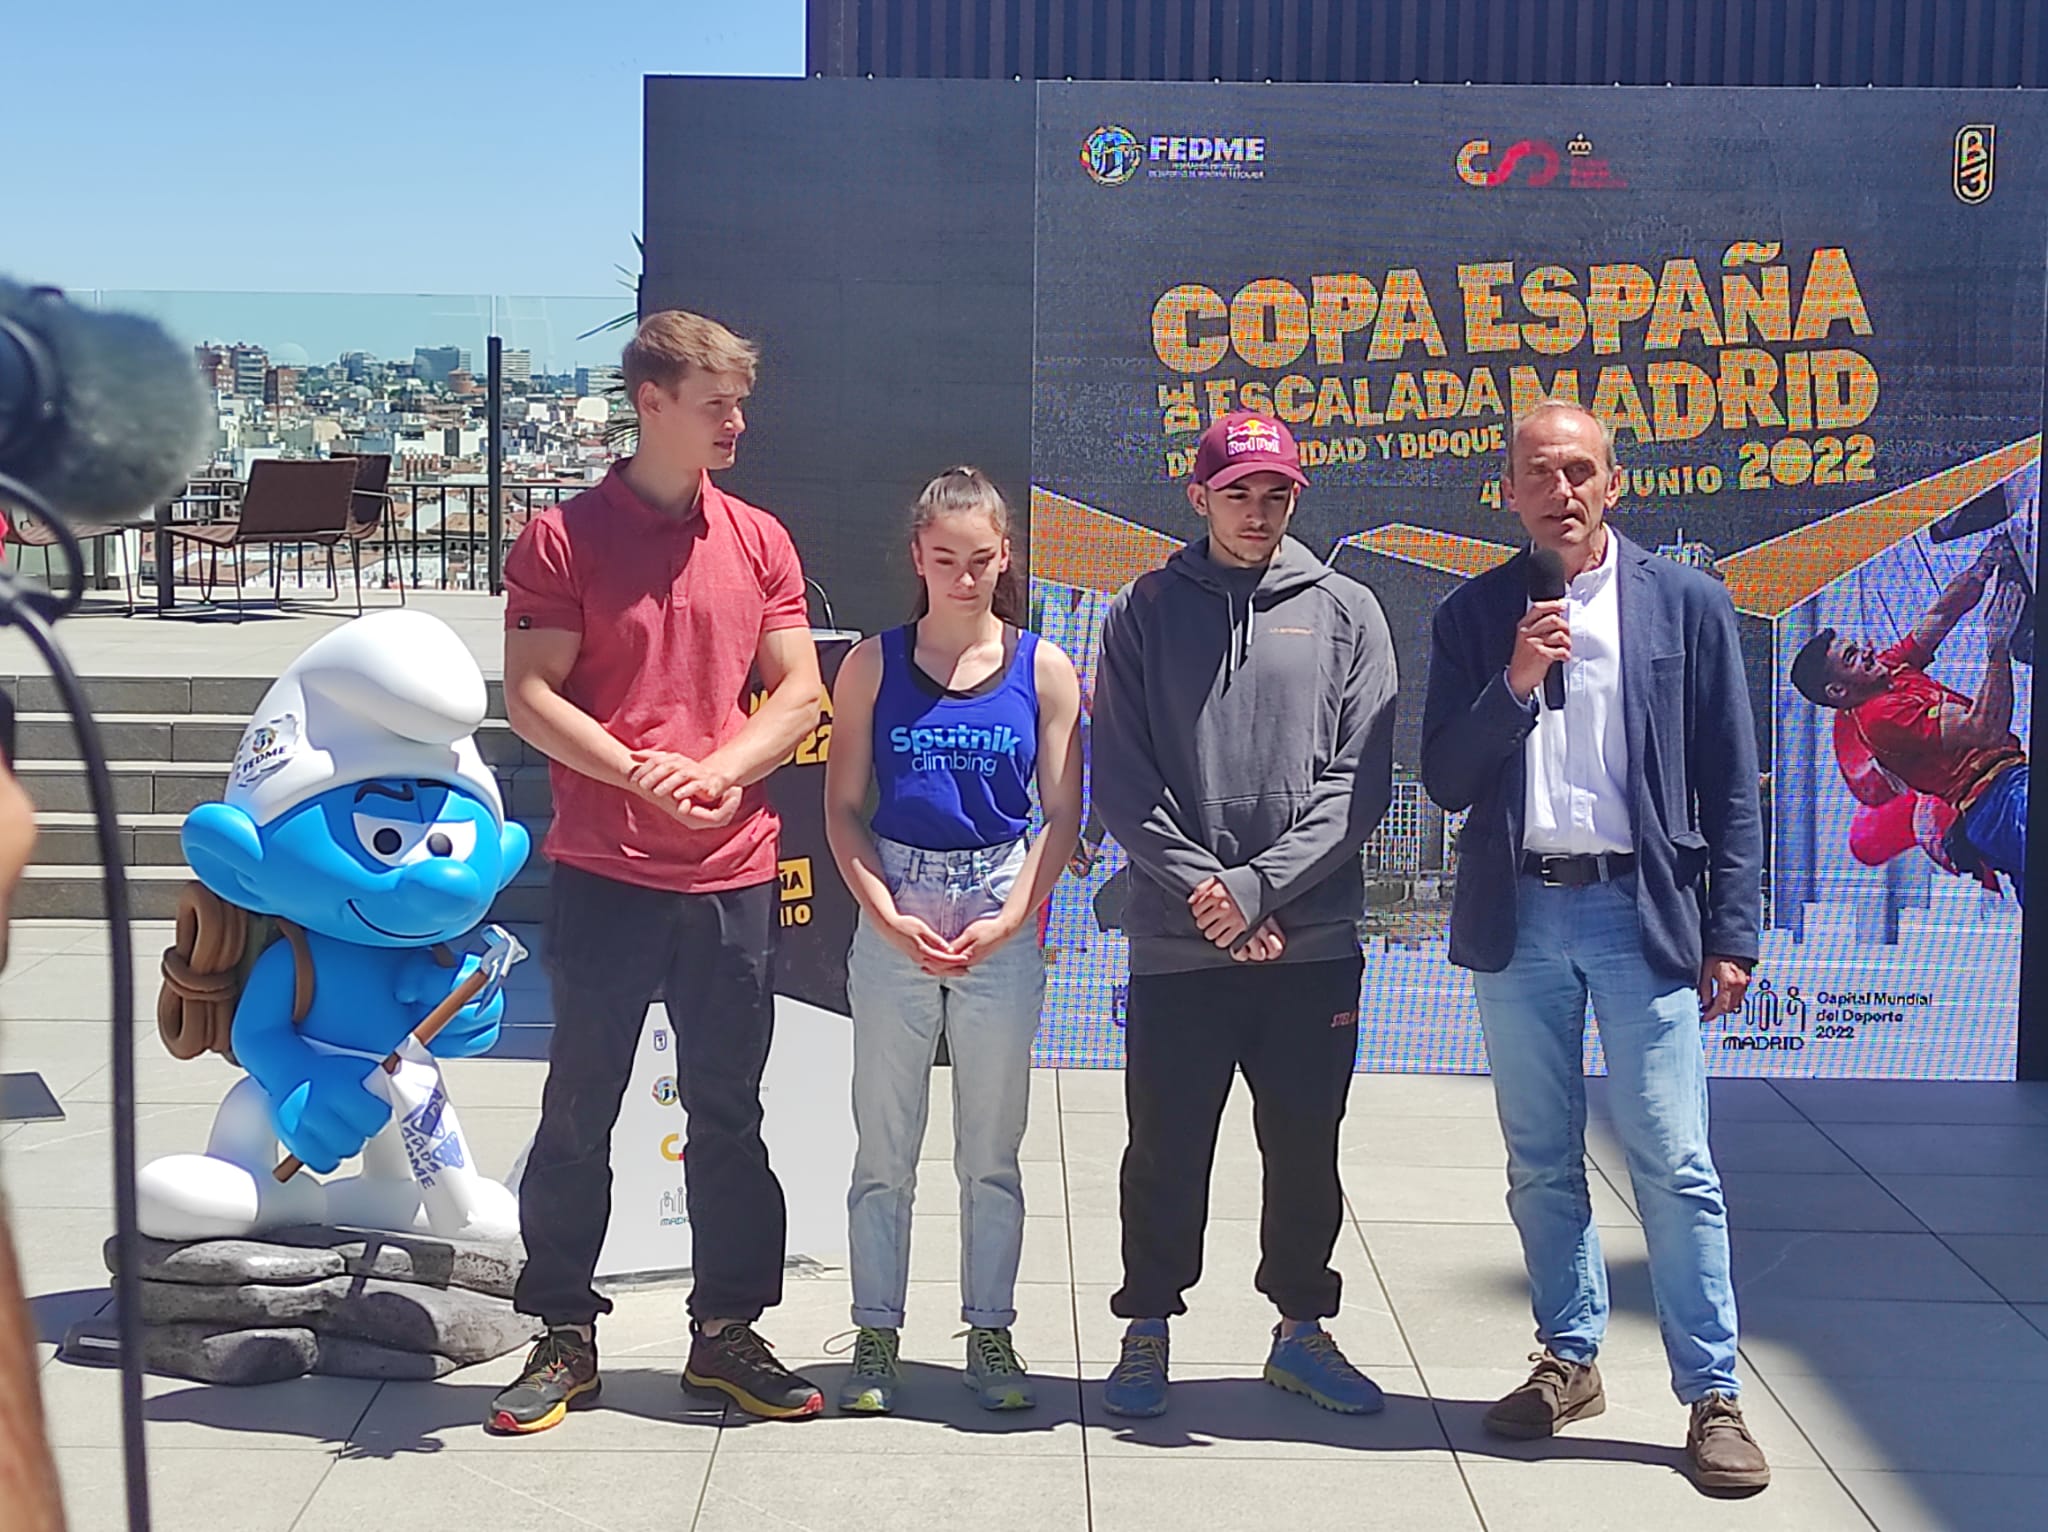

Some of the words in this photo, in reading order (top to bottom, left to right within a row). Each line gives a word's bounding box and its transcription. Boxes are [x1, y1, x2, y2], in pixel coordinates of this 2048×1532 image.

[1148, 136, 1265, 161] FEDME
[1152, 267, 1448, 373] COPA
[1457, 241, 1875, 355] ESPAÑA
[1205, 367, 1505, 427] ESCALADA
[1509, 348, 1880, 443] MADRID
[1375, 432, 1395, 460] Y
[1398, 423, 1506, 460] BLOQUE
[1480, 480, 1501, 509] 4
[1739, 434, 1876, 490] 2022
[912, 751, 998, 777] climbing
[1874, 992, 1933, 1007] Mundial
[1722, 1036, 1805, 1051] MADRID
[1815, 1026, 1855, 1039] 2022
